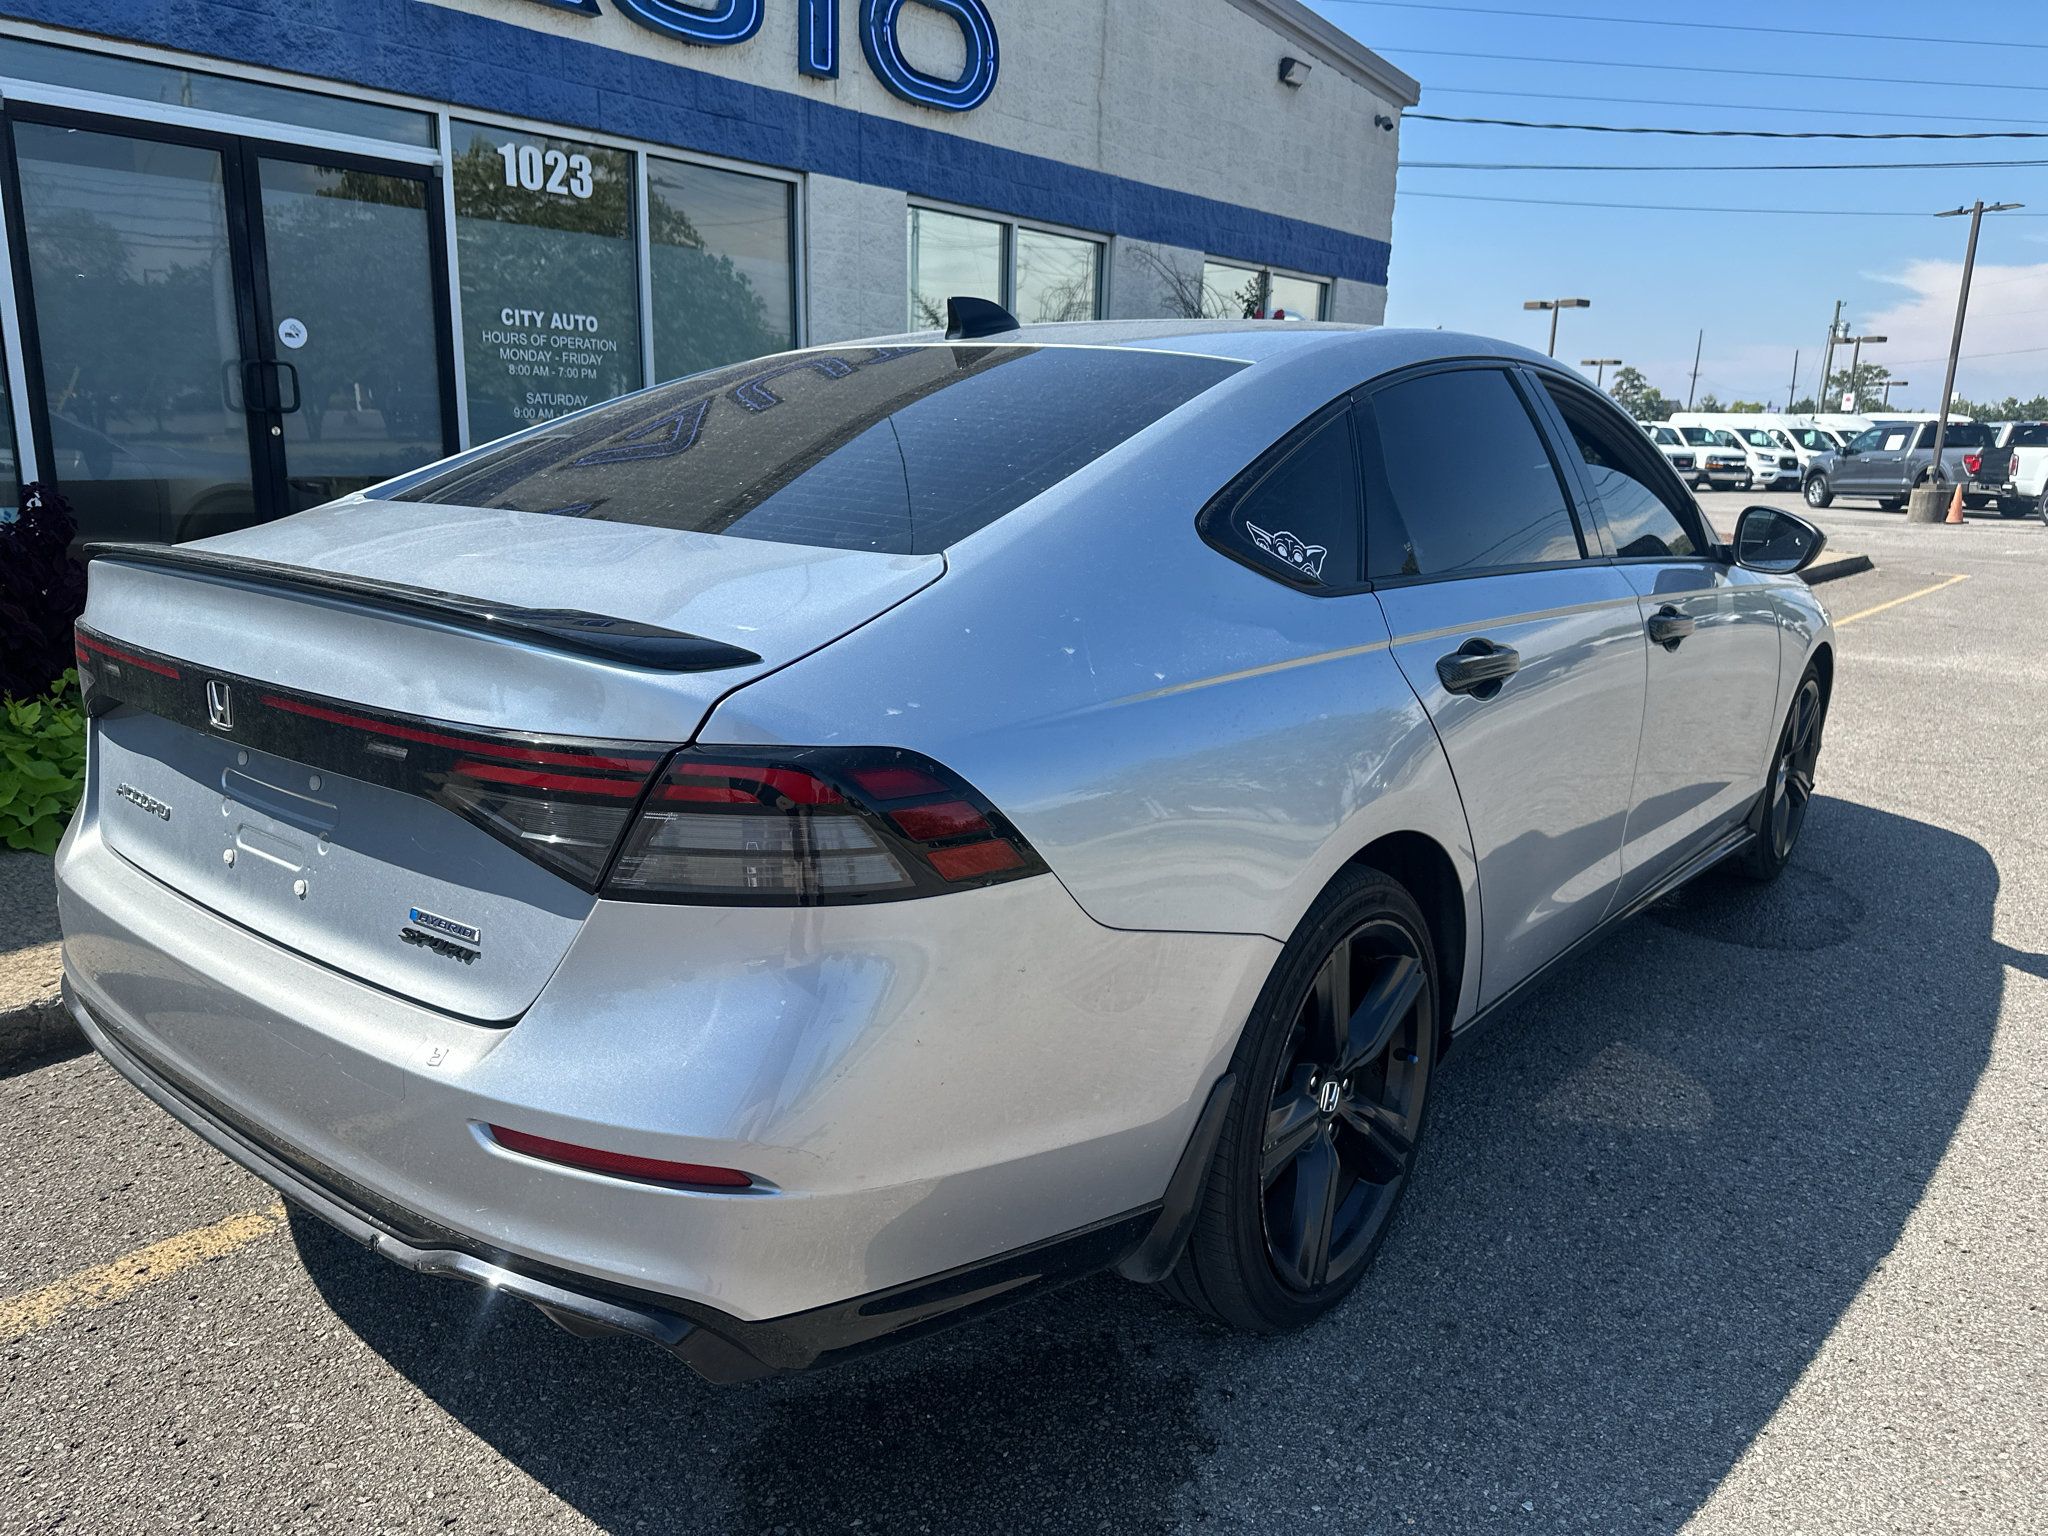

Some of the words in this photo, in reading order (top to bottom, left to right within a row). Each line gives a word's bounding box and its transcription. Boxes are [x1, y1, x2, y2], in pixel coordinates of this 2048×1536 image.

[497, 142, 594, 199] 1023
[501, 307, 545, 328] CITY
[550, 312, 598, 333] AUTO
[482, 330, 527, 346] HOURS
[530, 334, 547, 346] OF
[550, 335, 617, 352] OPERATION
[499, 348, 552, 362] MONDAY
[562, 352, 603, 365] FRIDAY
[508, 364, 530, 376] 8:00
[532, 366, 549, 377] AM
[558, 367, 578, 379] 7:00
[581, 368, 597, 379] PM
[526, 392, 588, 406] SATURDAY
[513, 406, 536, 419] 9:00
[537, 408, 554, 419] AM
[116, 782, 172, 822] ACCORD
[418, 910, 473, 938] HYBRID
[398, 927, 482, 965] SPORT
